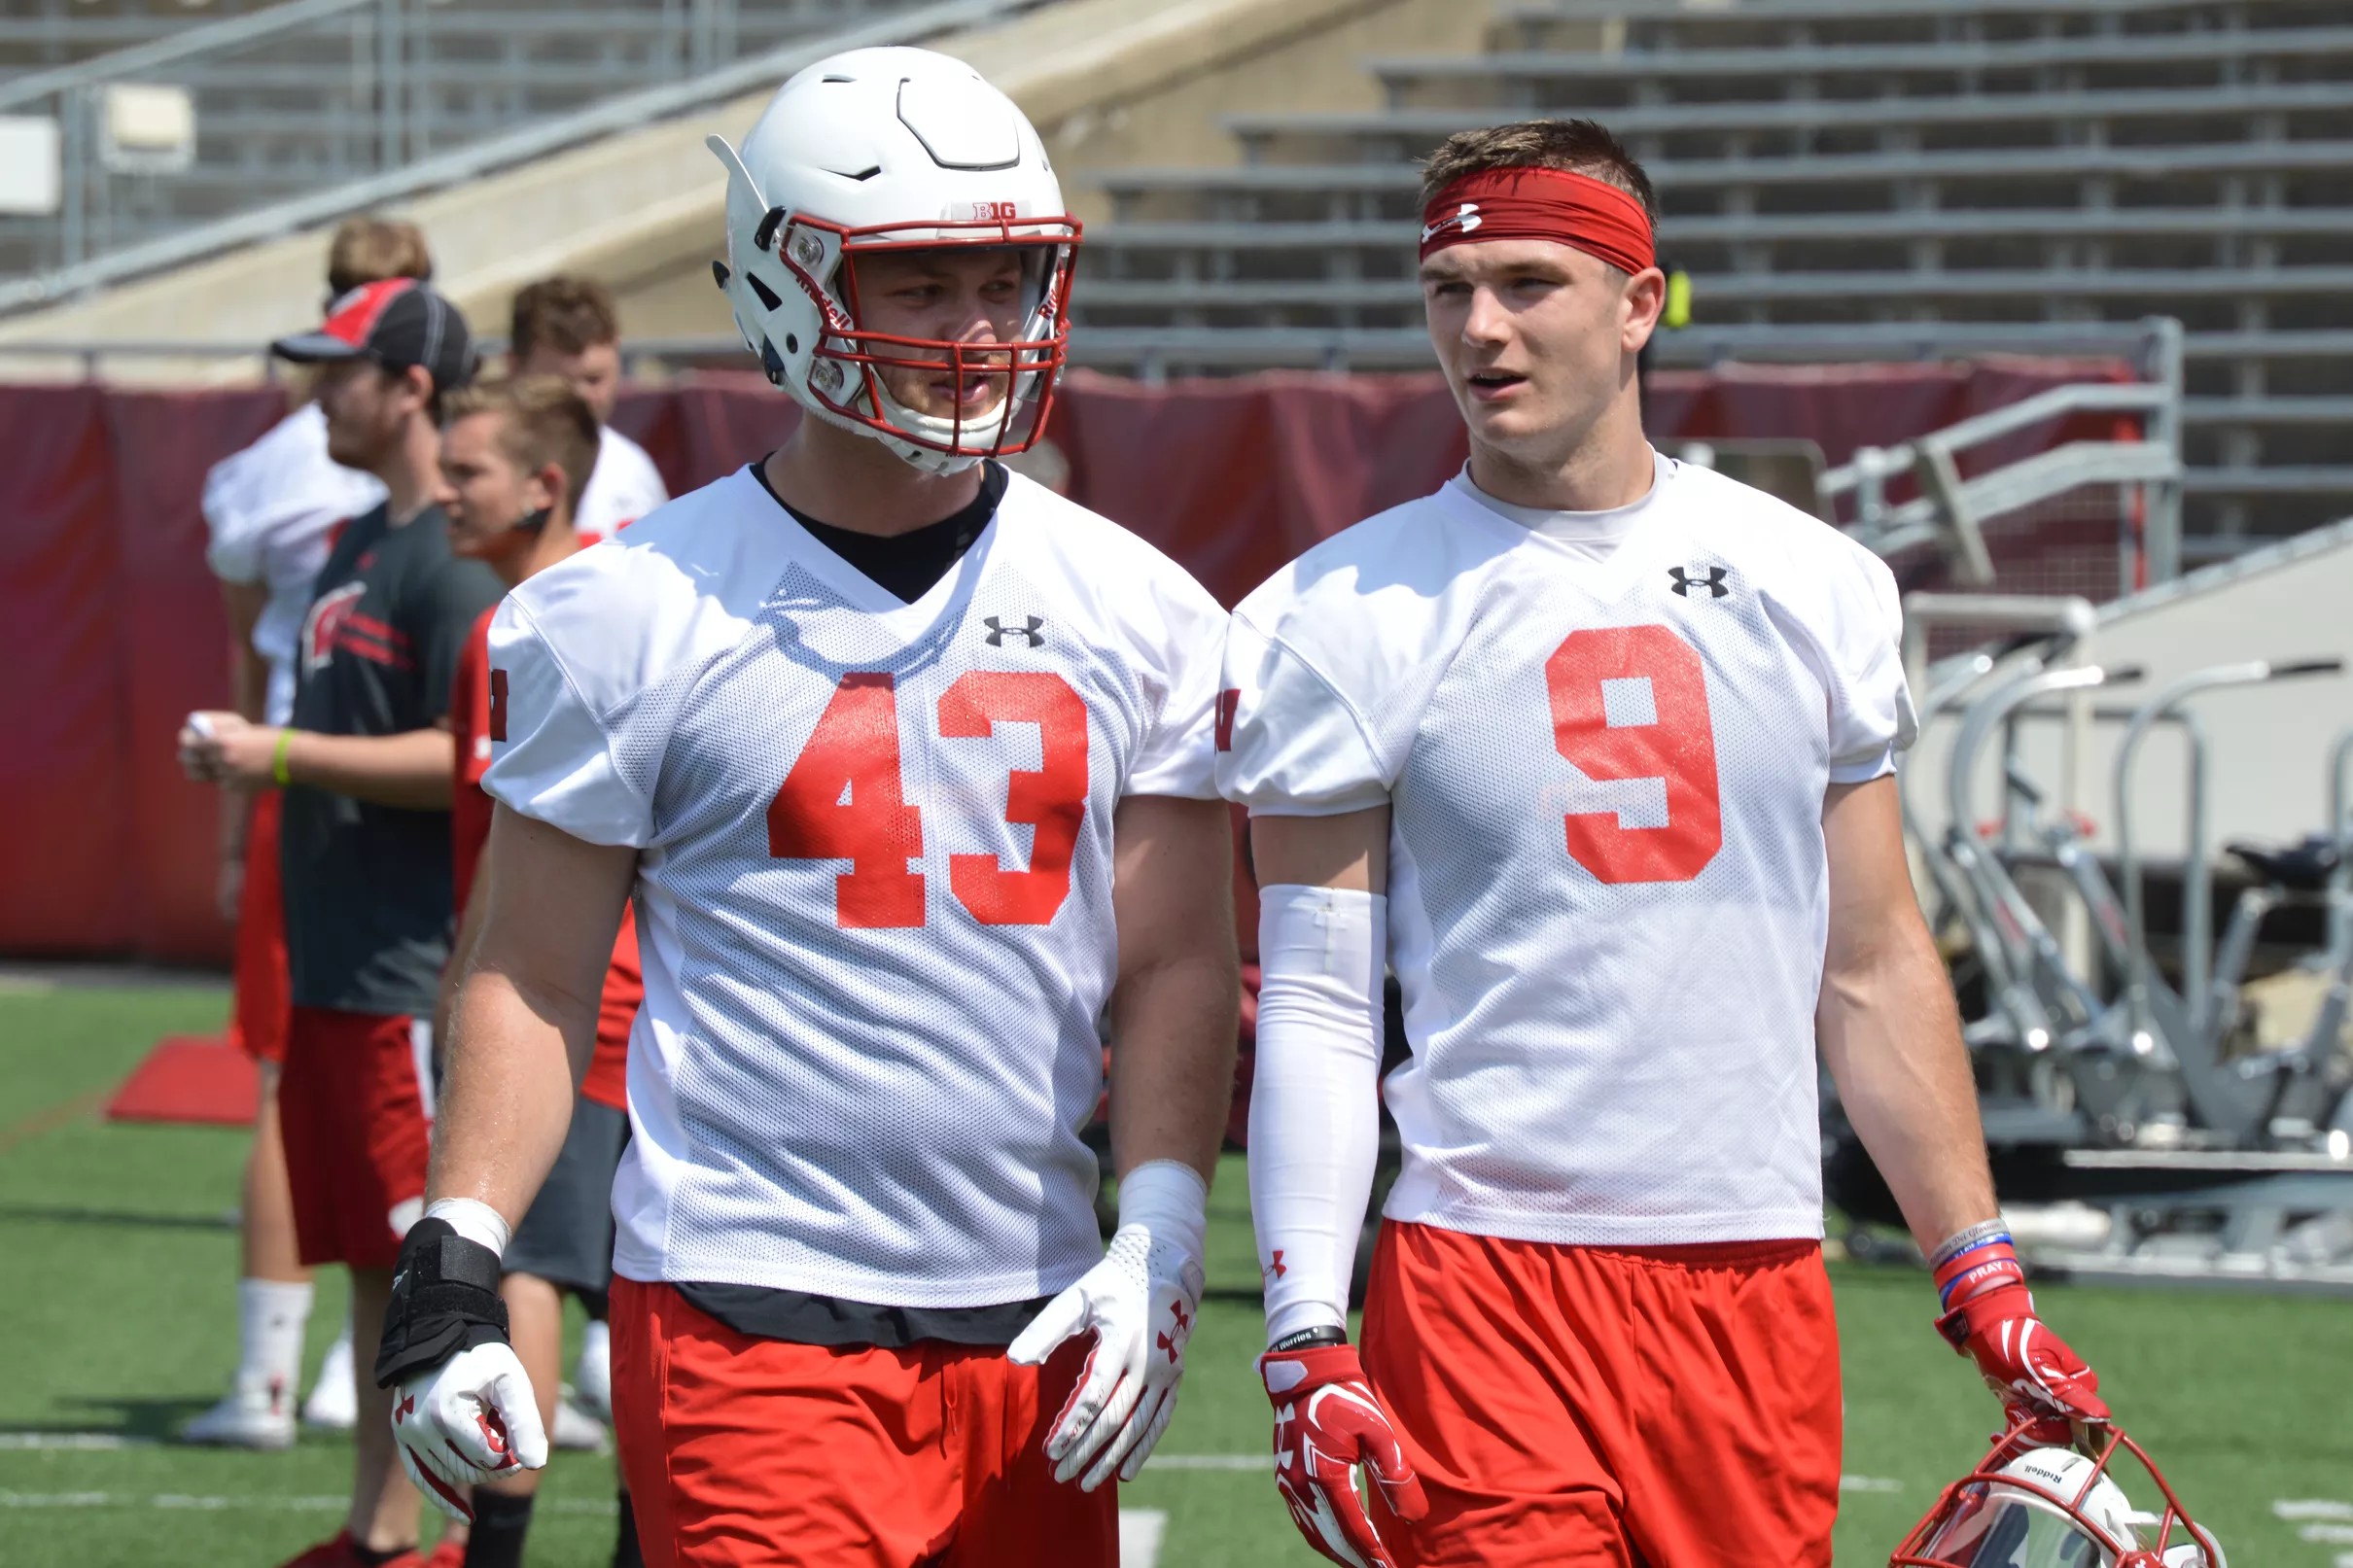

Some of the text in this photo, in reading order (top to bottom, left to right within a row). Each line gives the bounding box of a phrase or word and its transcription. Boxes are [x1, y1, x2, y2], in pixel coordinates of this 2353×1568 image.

[1544, 624, 1723, 885] 9
[766, 670, 1089, 928] 43
[1968, 1261, 2003, 1284] PRAY
[1279, 1331, 1312, 1352] Worries
[2024, 1465, 2062, 1484] Riddell
